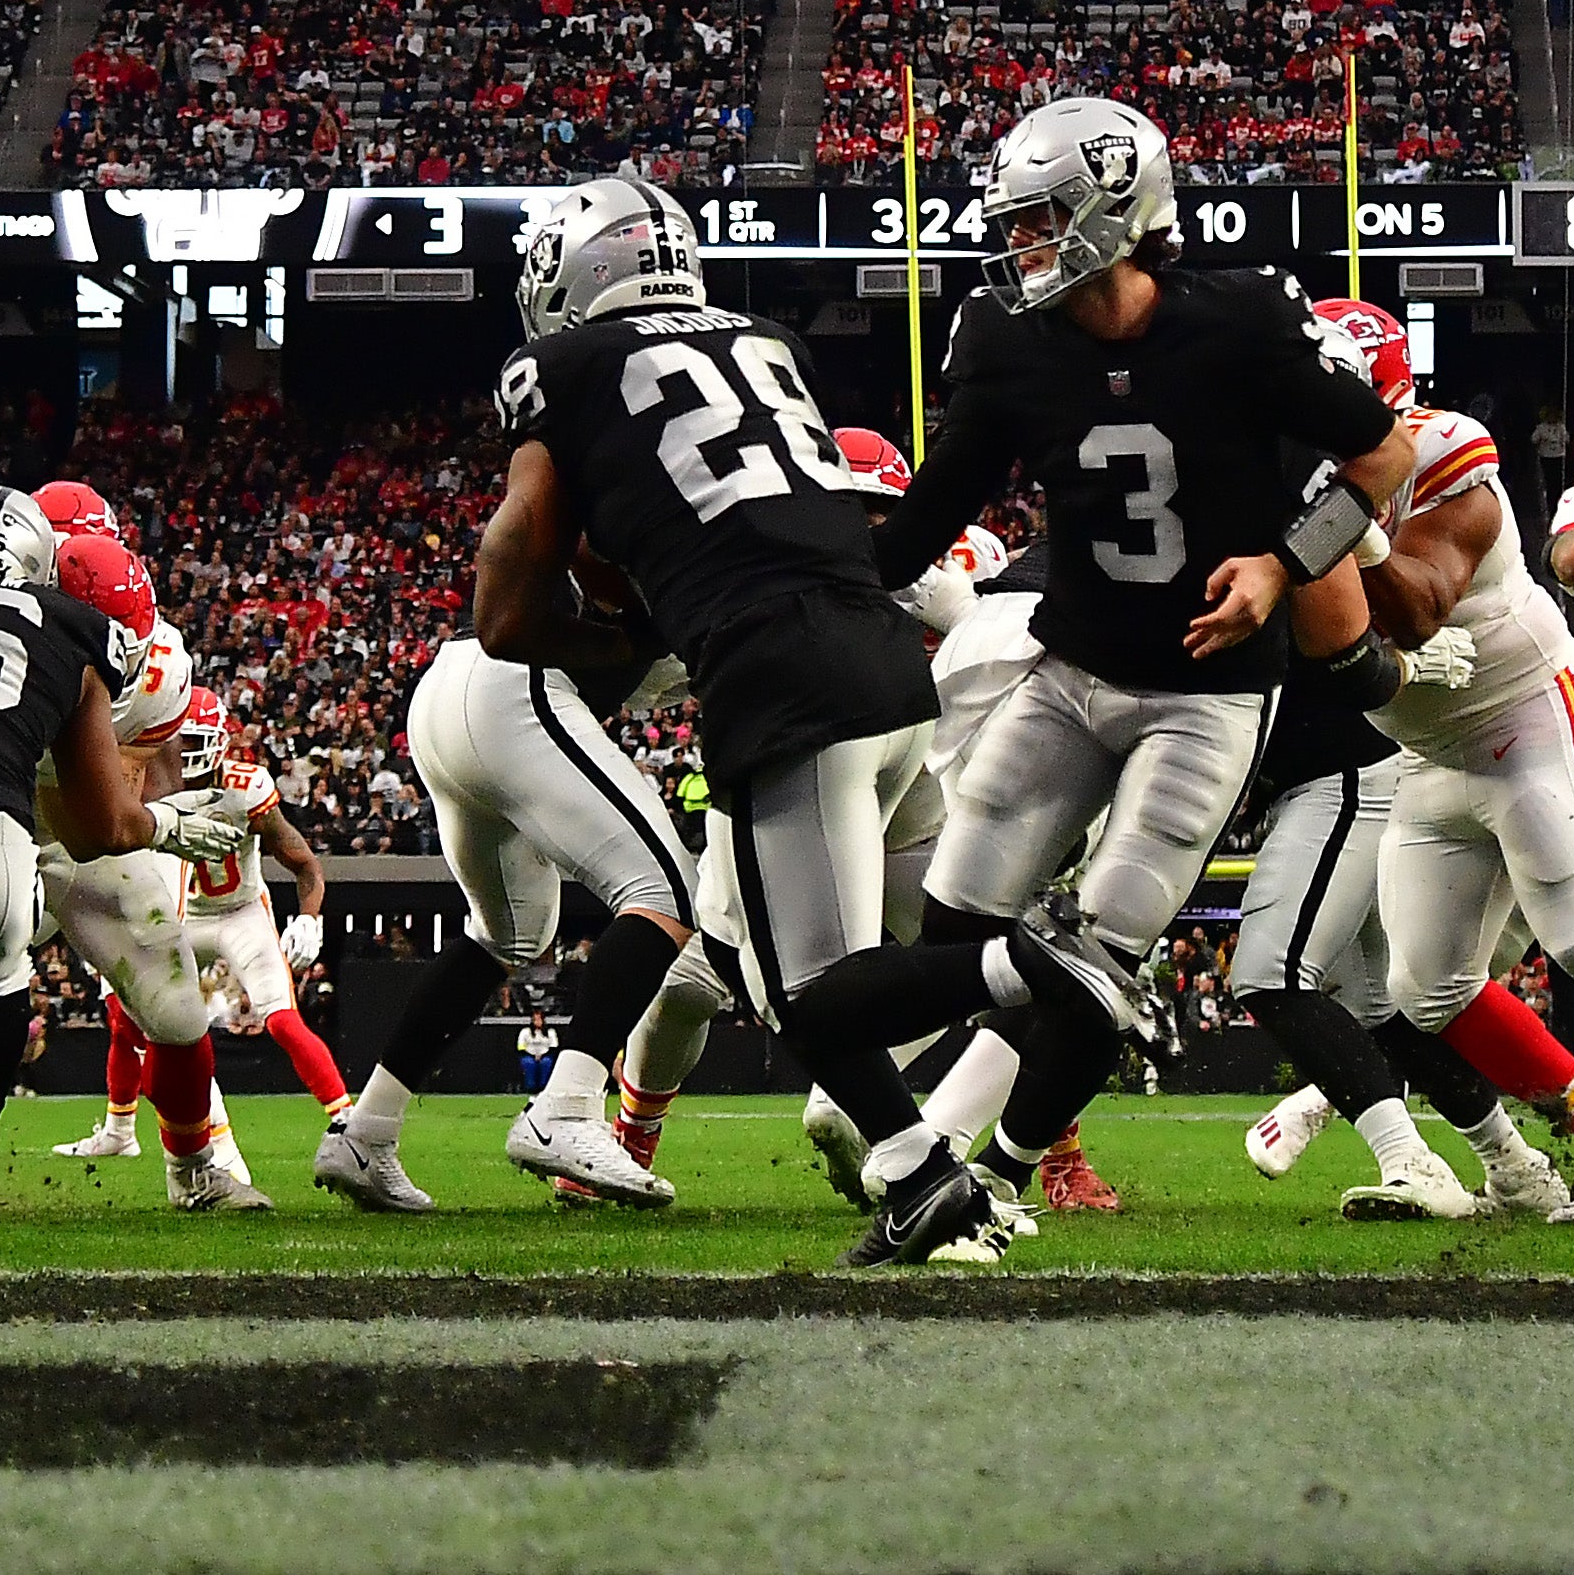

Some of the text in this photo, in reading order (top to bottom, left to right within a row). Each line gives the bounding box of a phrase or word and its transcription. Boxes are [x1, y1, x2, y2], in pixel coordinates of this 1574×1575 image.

[423, 196, 464, 254] 3
[700, 200, 758, 244] 1 ST
[1195, 201, 1246, 243] 10
[1356, 202, 1445, 235] ON 5
[638, 249, 688, 274] 28
[640, 282, 694, 299] RAIDERS
[620, 335, 856, 525] 28
[1078, 423, 1187, 584] 3
